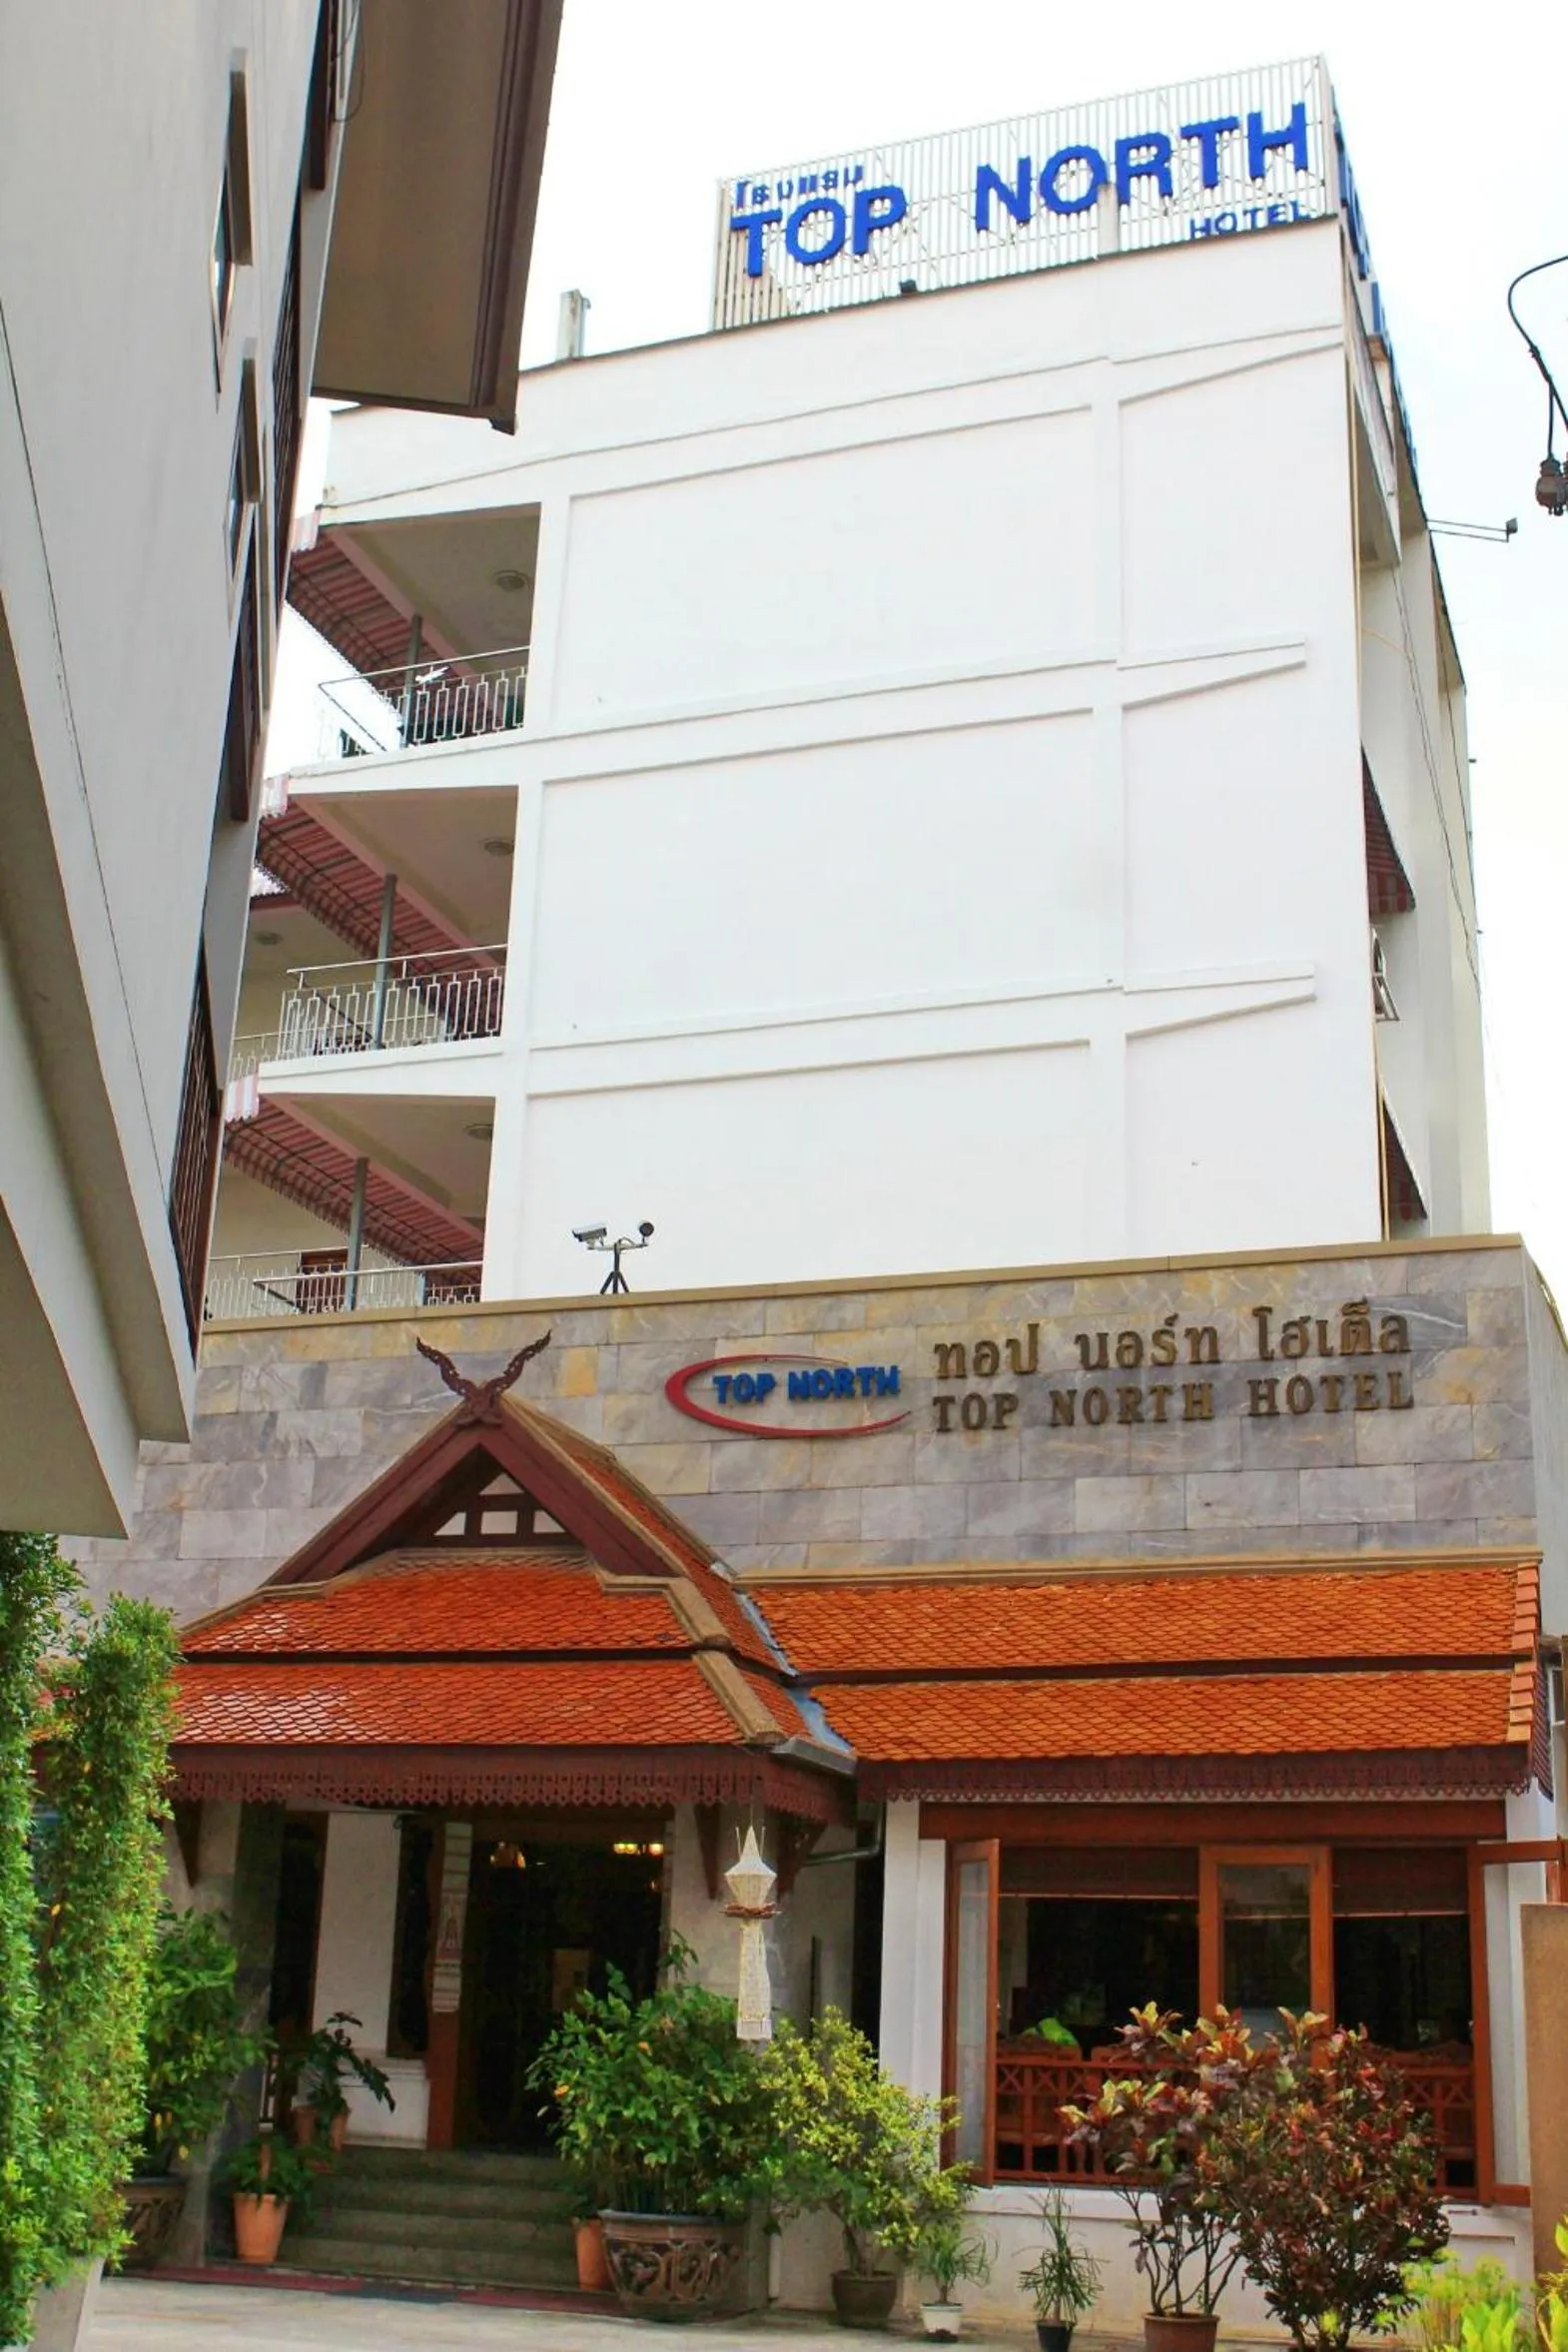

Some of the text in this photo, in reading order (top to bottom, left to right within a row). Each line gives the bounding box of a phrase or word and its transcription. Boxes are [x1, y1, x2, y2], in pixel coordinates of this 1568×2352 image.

[730, 102, 1309, 279] TOP NORTH
[1189, 199, 1311, 239] HOTEL
[934, 1295, 1412, 1379] ทอป นอร์ท โฮเต็ล
[713, 1364, 901, 1404] TOP NORTH
[932, 1370, 1414, 1433] TOP NORTH HOTEL
